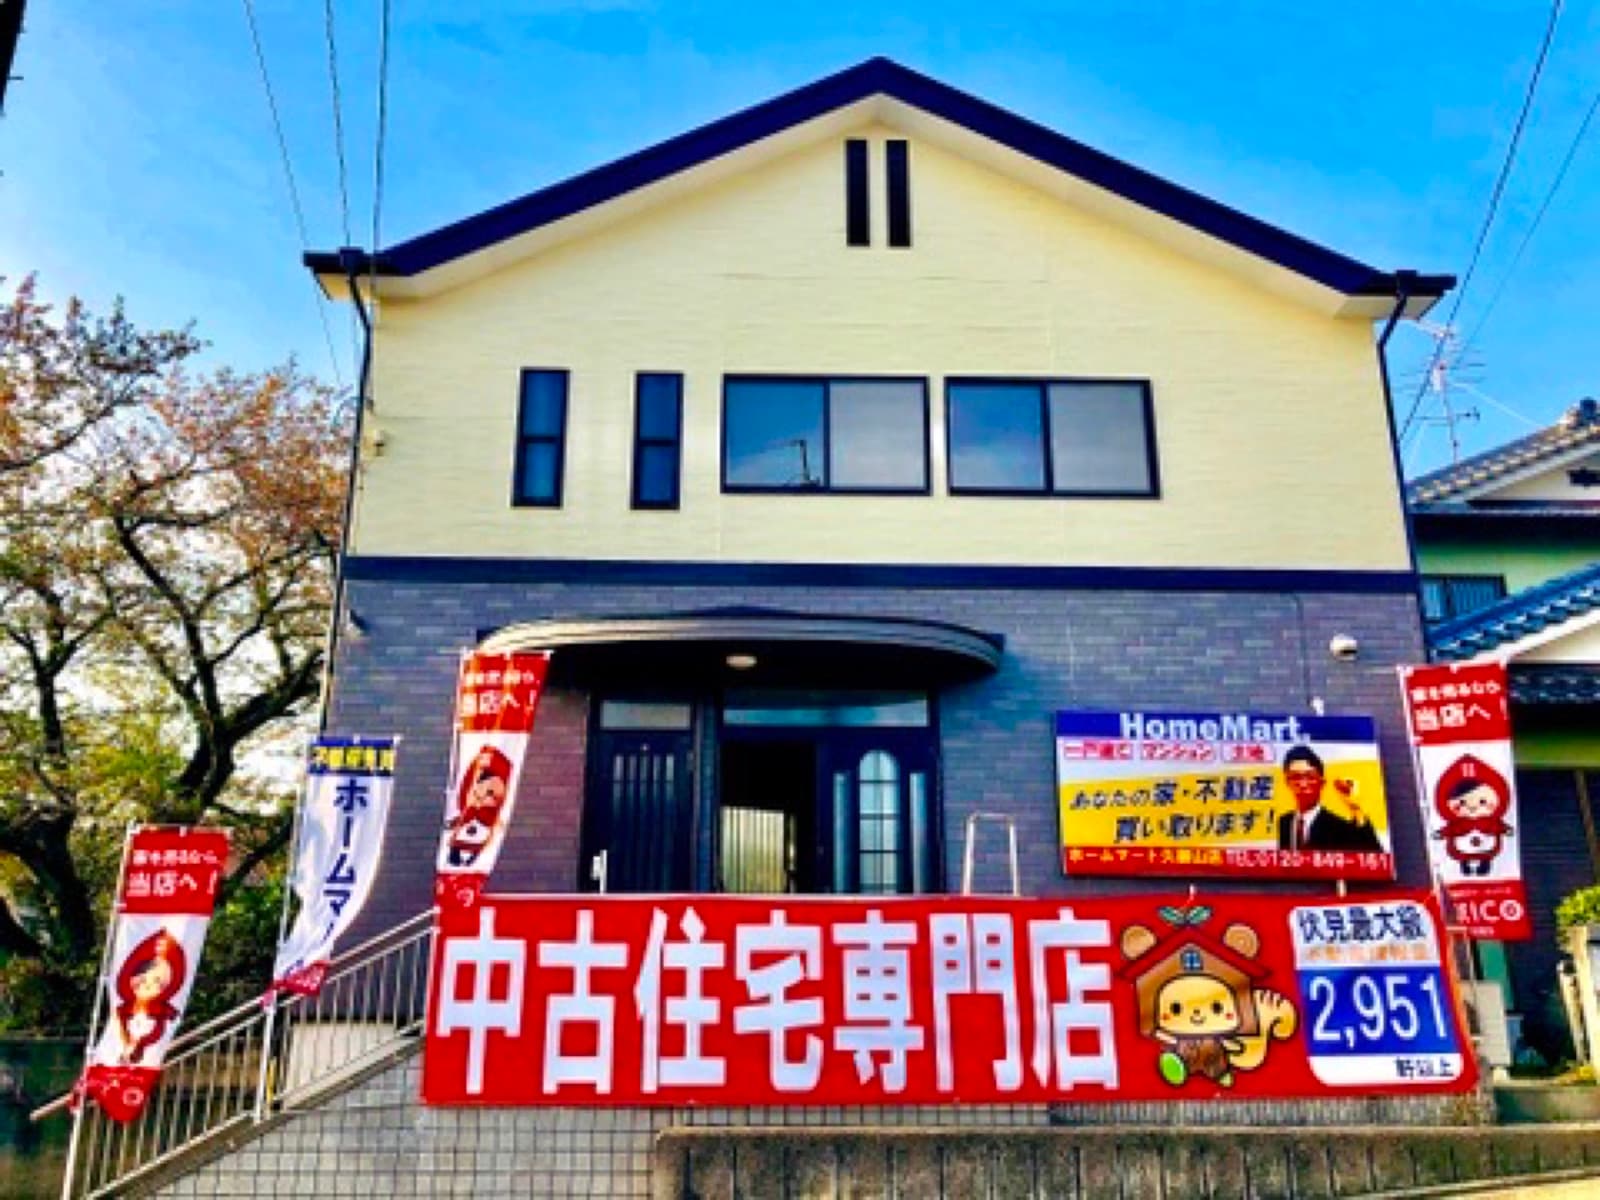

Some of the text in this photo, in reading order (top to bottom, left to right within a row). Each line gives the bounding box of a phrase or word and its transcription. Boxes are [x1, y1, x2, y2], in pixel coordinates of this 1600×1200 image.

[437, 906, 1120, 1094] 中古住宅専門店
[1309, 974, 1448, 1050] 2,951
